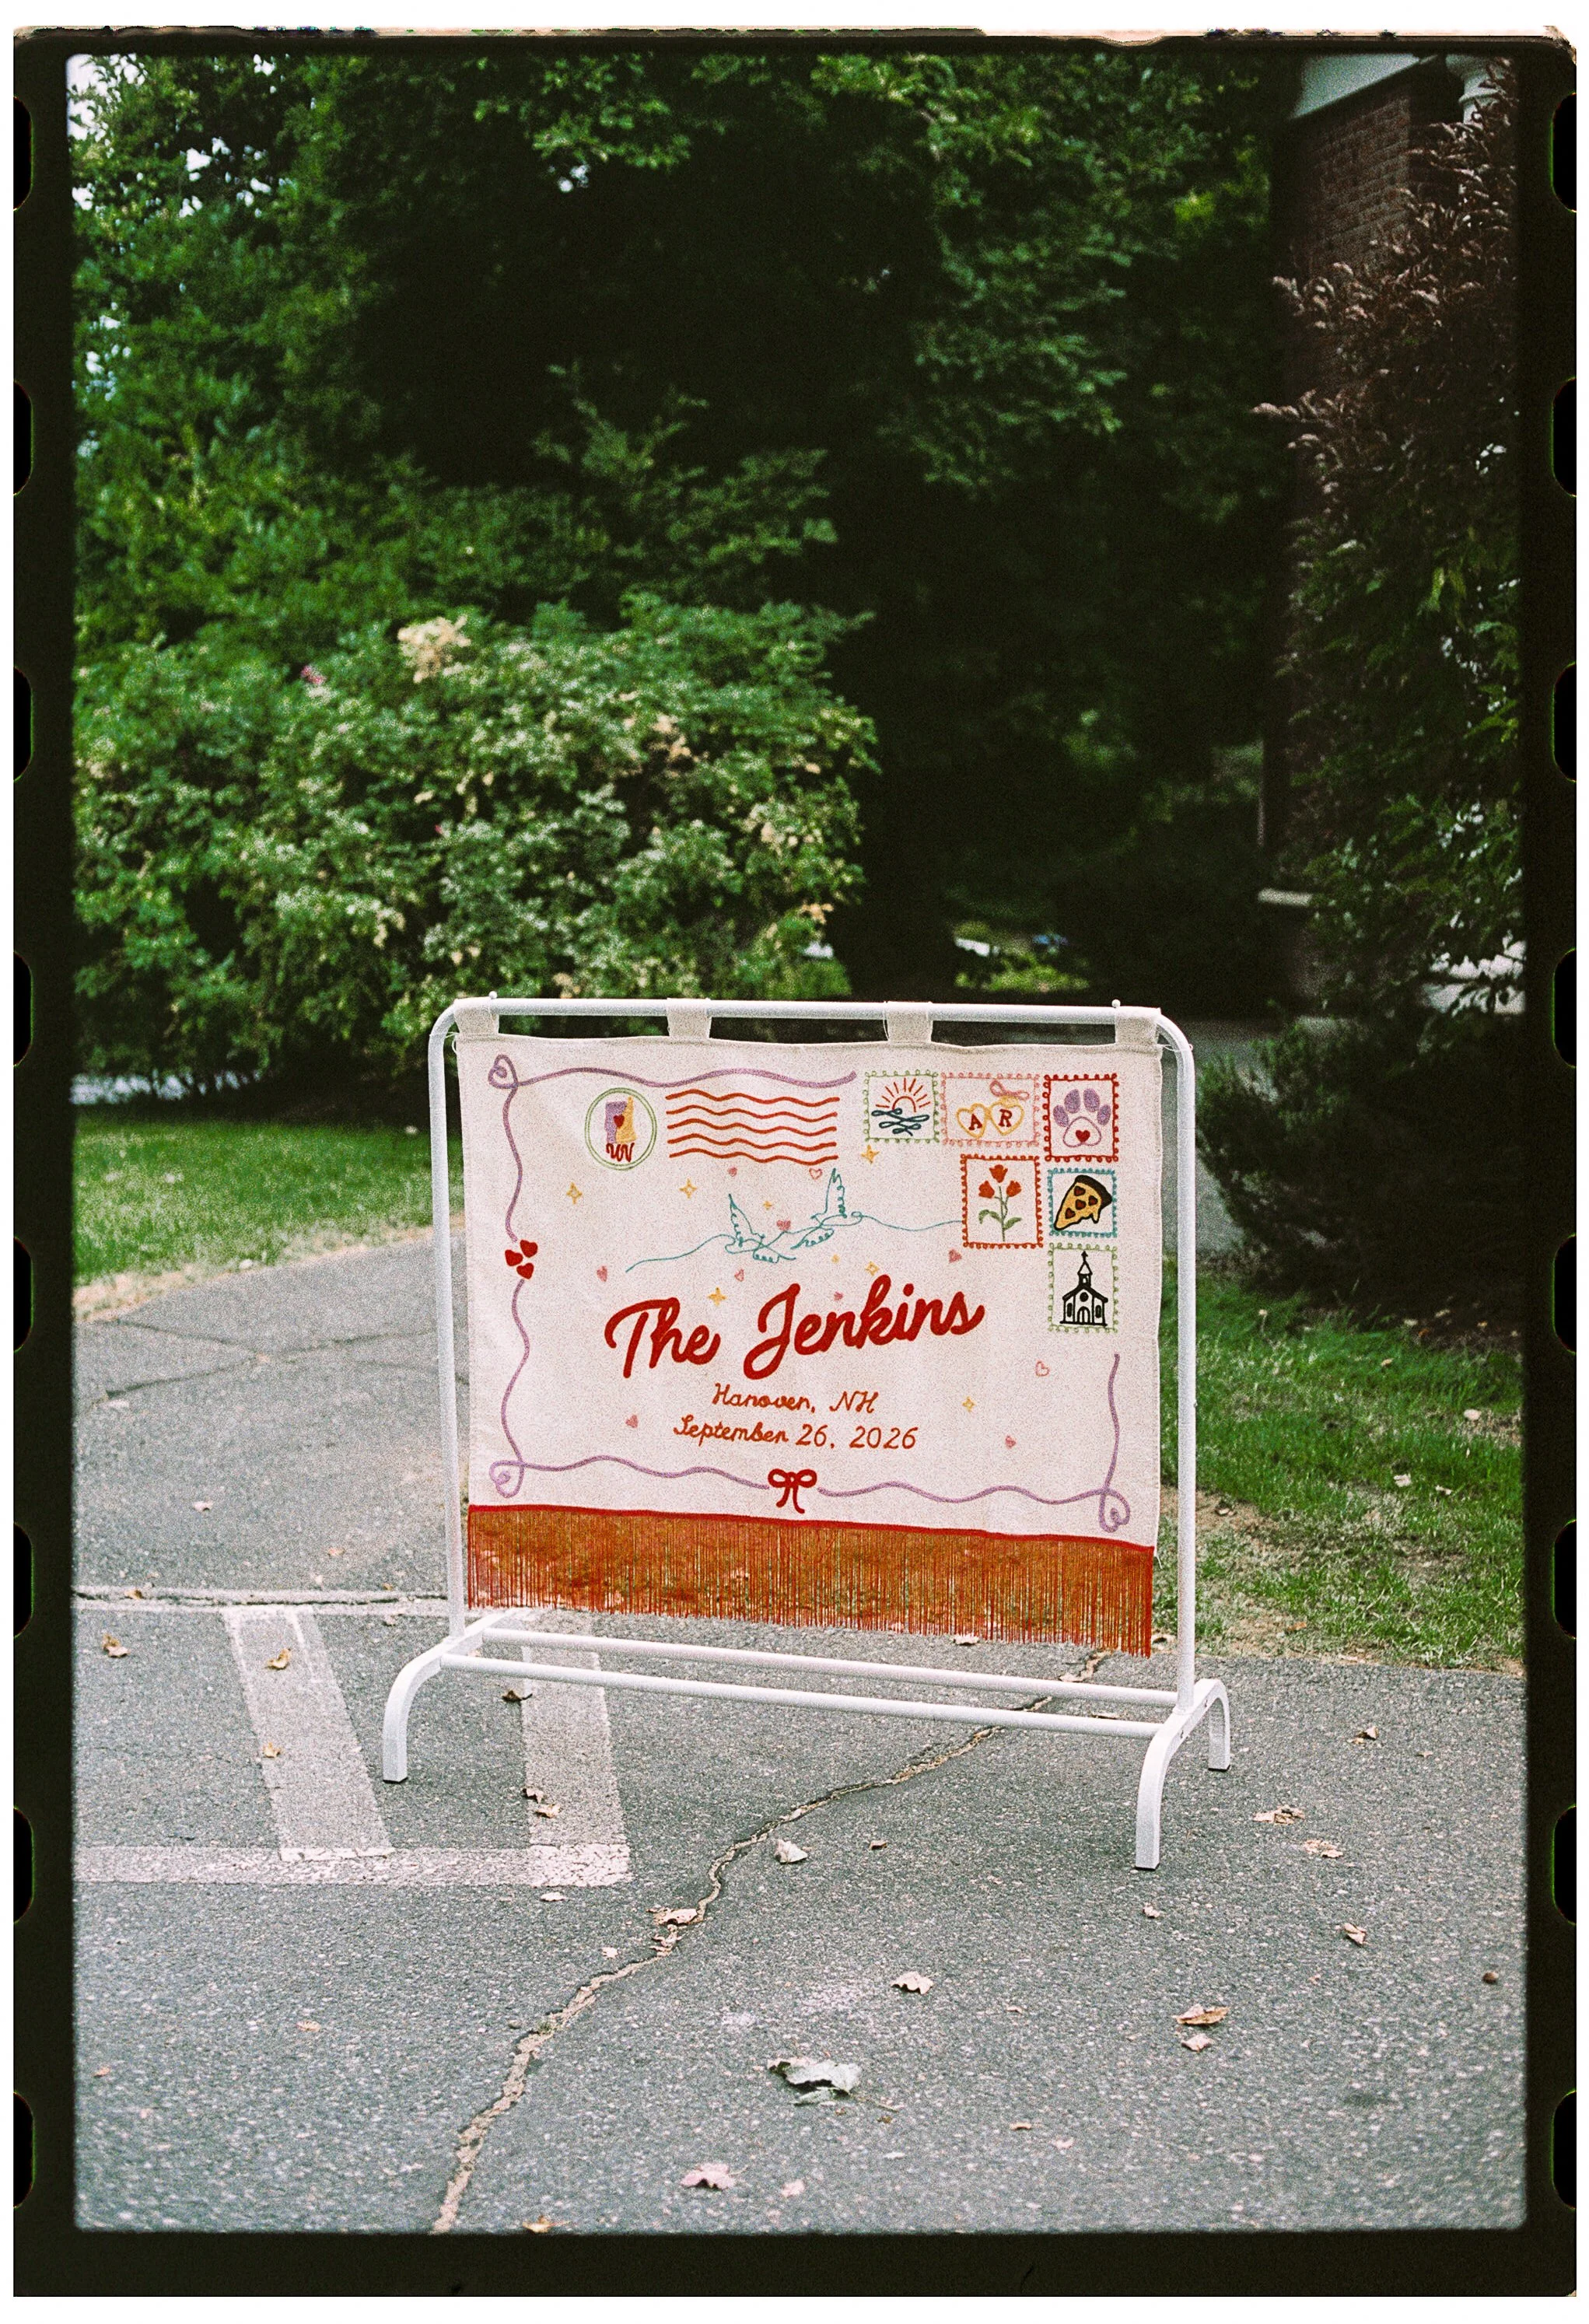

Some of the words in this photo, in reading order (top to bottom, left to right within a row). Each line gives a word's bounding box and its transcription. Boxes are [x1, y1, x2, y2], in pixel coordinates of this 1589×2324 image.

[968, 1113, 982, 1131] A
[998, 1108, 1013, 1128] R
[604, 1297, 722, 1379] The
[744, 1274, 985, 1381] Jenkins
[711, 1383, 817, 1414] Hanover,
[829, 1391, 880, 1415] NH
[673, 1414, 790, 1447] September
[795, 1423, 836, 1450] 26,
[849, 1426, 919, 1450] 2026
